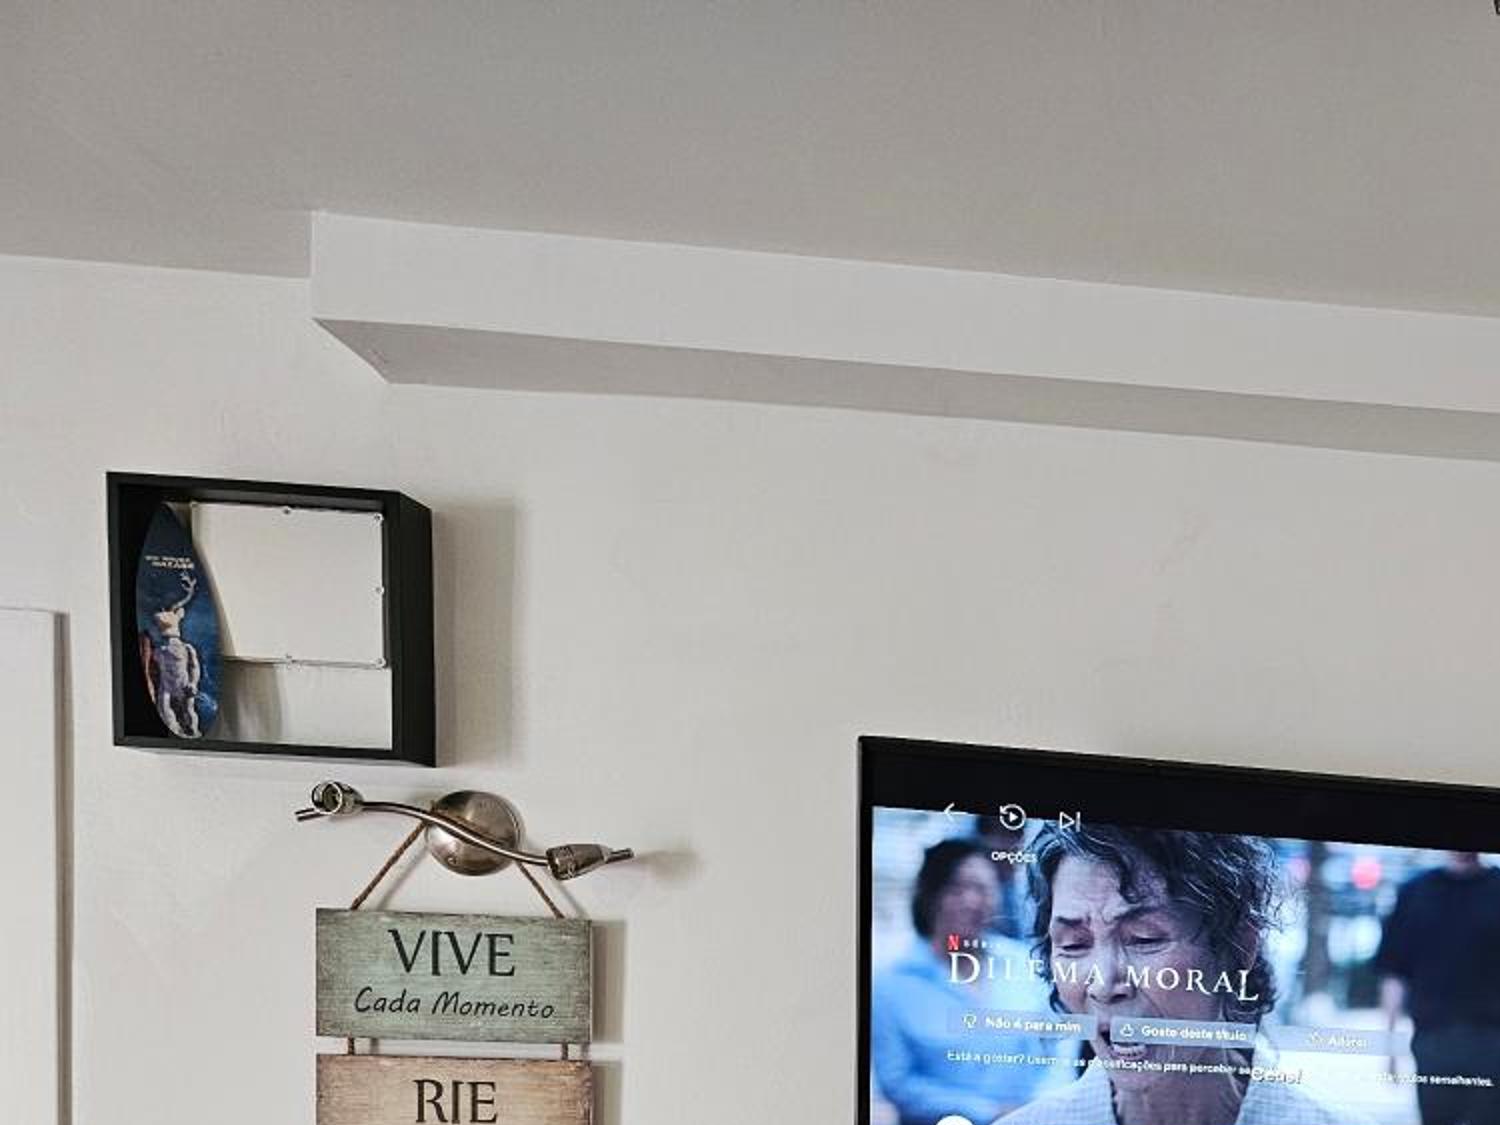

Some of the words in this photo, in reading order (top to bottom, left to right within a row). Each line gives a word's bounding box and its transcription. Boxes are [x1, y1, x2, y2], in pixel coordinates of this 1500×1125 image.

[991, 850, 1038, 864] OPÇÕES
[388, 928, 516, 977] VIVE
[948, 952, 1105, 984] DILEMA
[1125, 965, 1259, 1001] MORAL
[354, 986, 421, 1014] Cada
[431, 990, 556, 1020] Momento
[985, 1016, 1010, 1029] Não
[1024, 1021, 1053, 1032] para
[1055, 1022, 1081, 1032] mim
[1164, 1062, 1188, 1073] para
[413, 1079, 499, 1125] RIE
